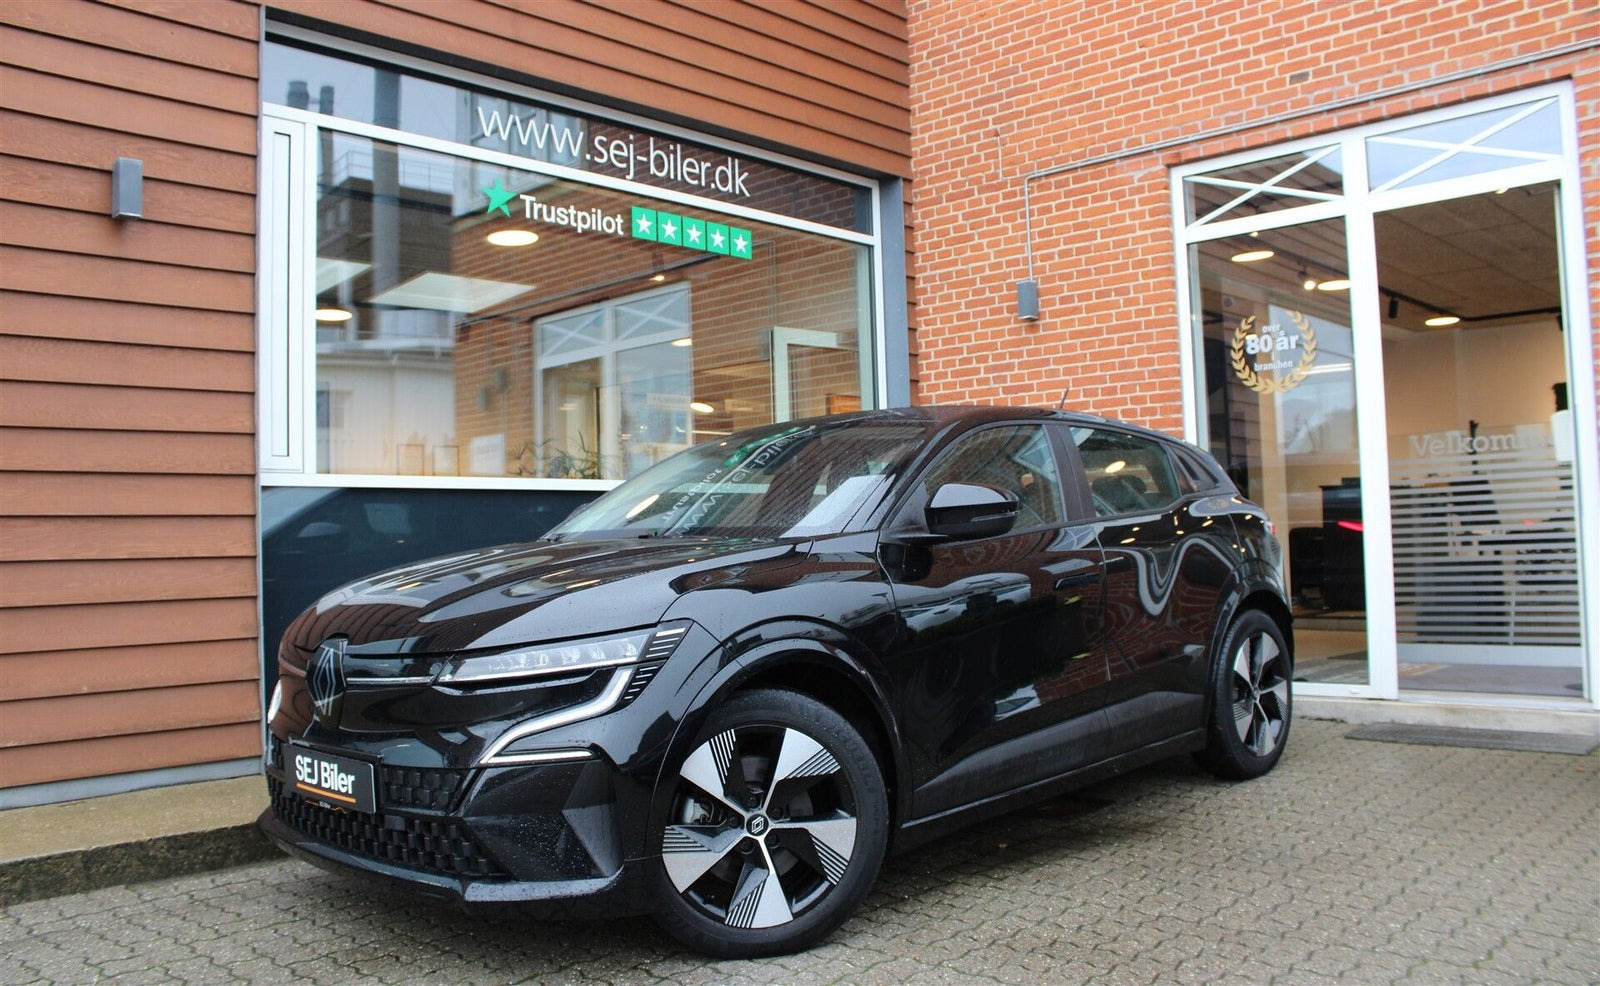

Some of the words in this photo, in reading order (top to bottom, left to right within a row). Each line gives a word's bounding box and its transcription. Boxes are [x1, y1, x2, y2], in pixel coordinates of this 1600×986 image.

[477, 105, 751, 198] www.sej-biler.dk
[519, 193, 624, 236] Trustpilot
[1245, 334, 1273, 355] 80
[1276, 330, 1299, 351] år
[1262, 324, 1281, 333] over
[1408, 429, 1556, 457] Velkom
[295, 754, 319, 785] SEJ
[320, 761, 355, 794] Biler
